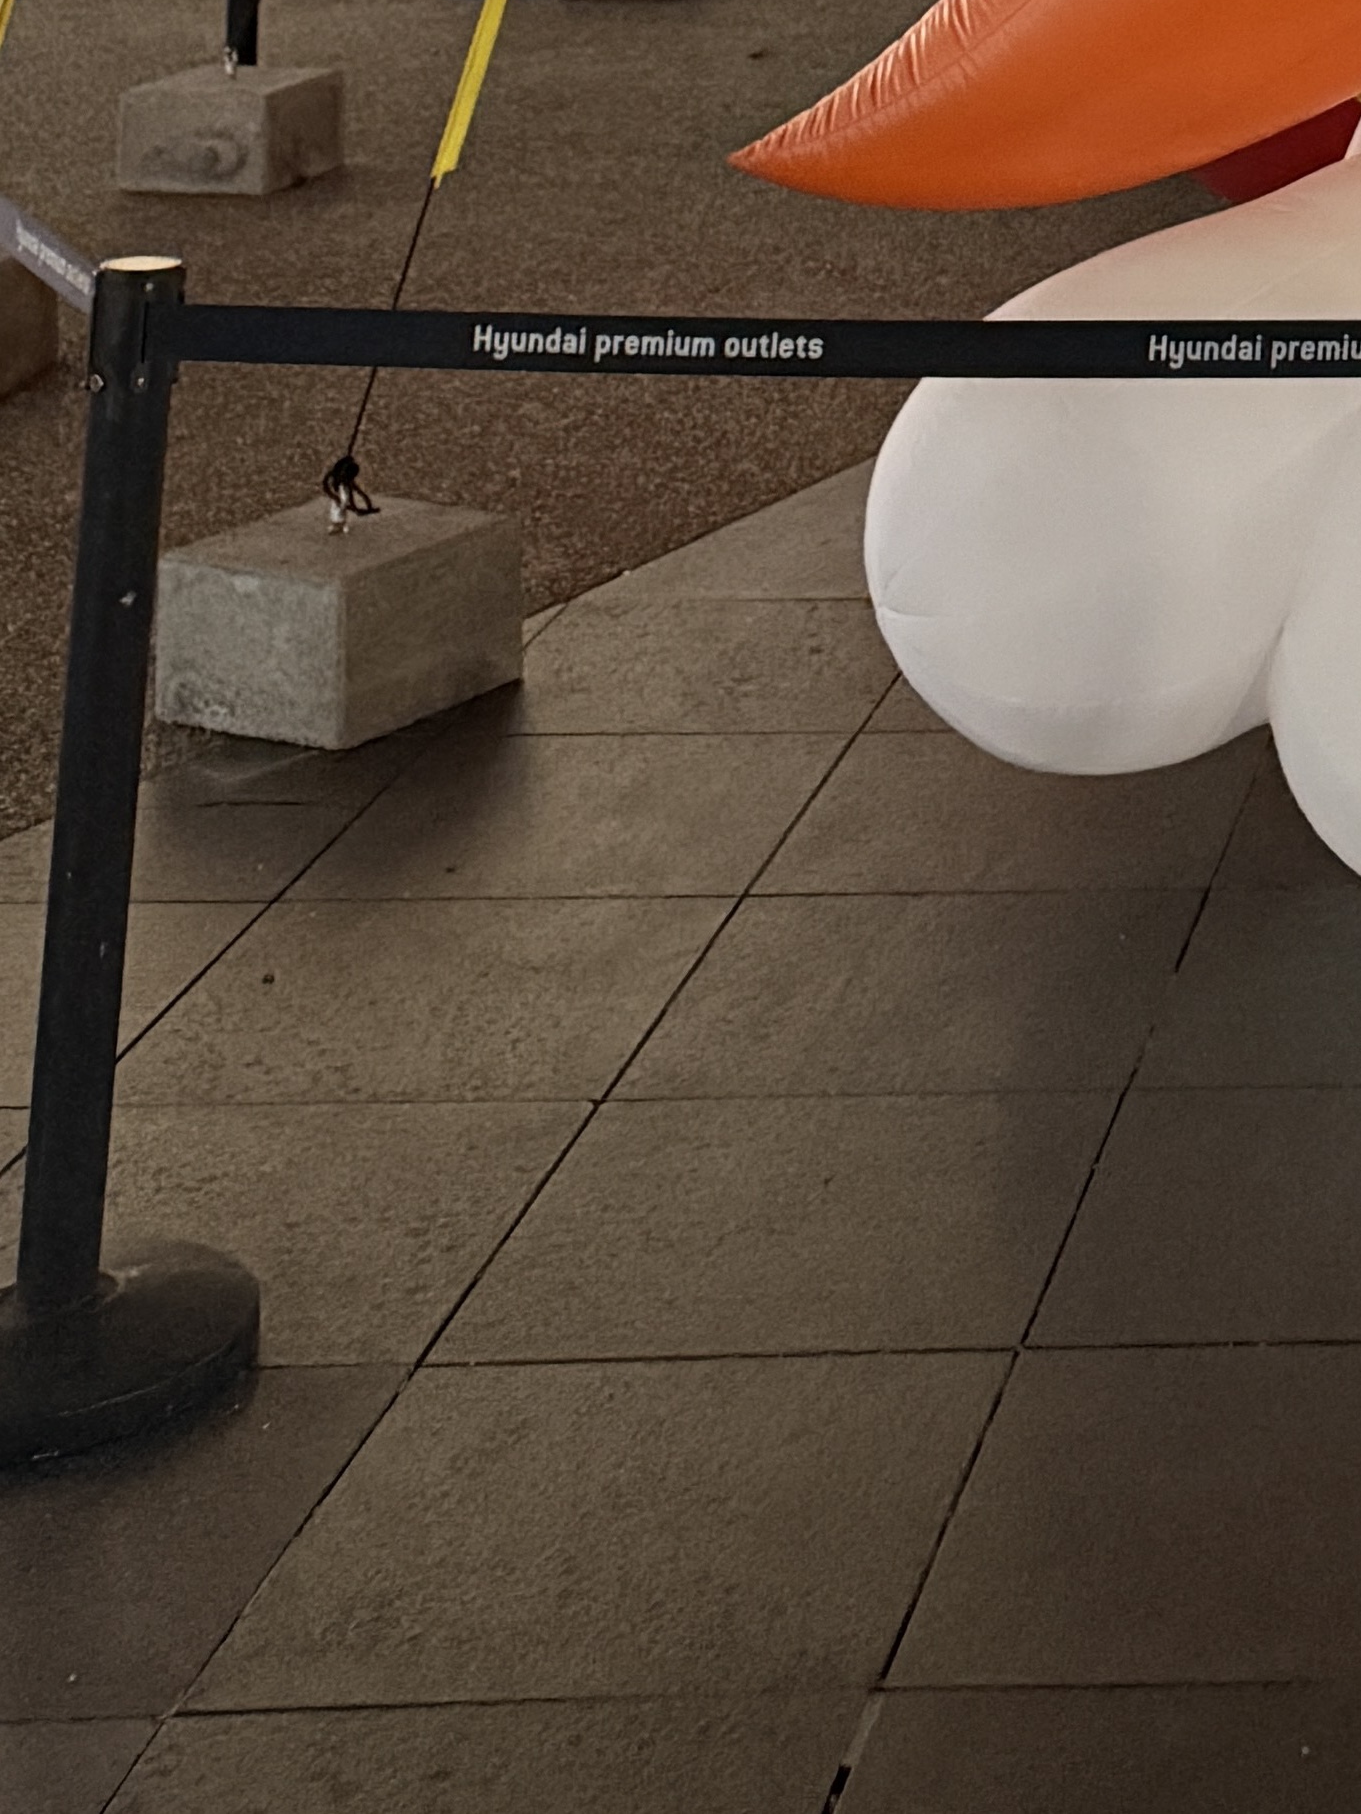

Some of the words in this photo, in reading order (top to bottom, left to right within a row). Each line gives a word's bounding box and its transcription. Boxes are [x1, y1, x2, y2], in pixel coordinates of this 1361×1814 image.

[473, 325, 587, 360] Hyundai
[594, 330, 716, 363] premium
[724, 332, 824, 360] outlets
[1148, 334, 1262, 369] Hyundai
